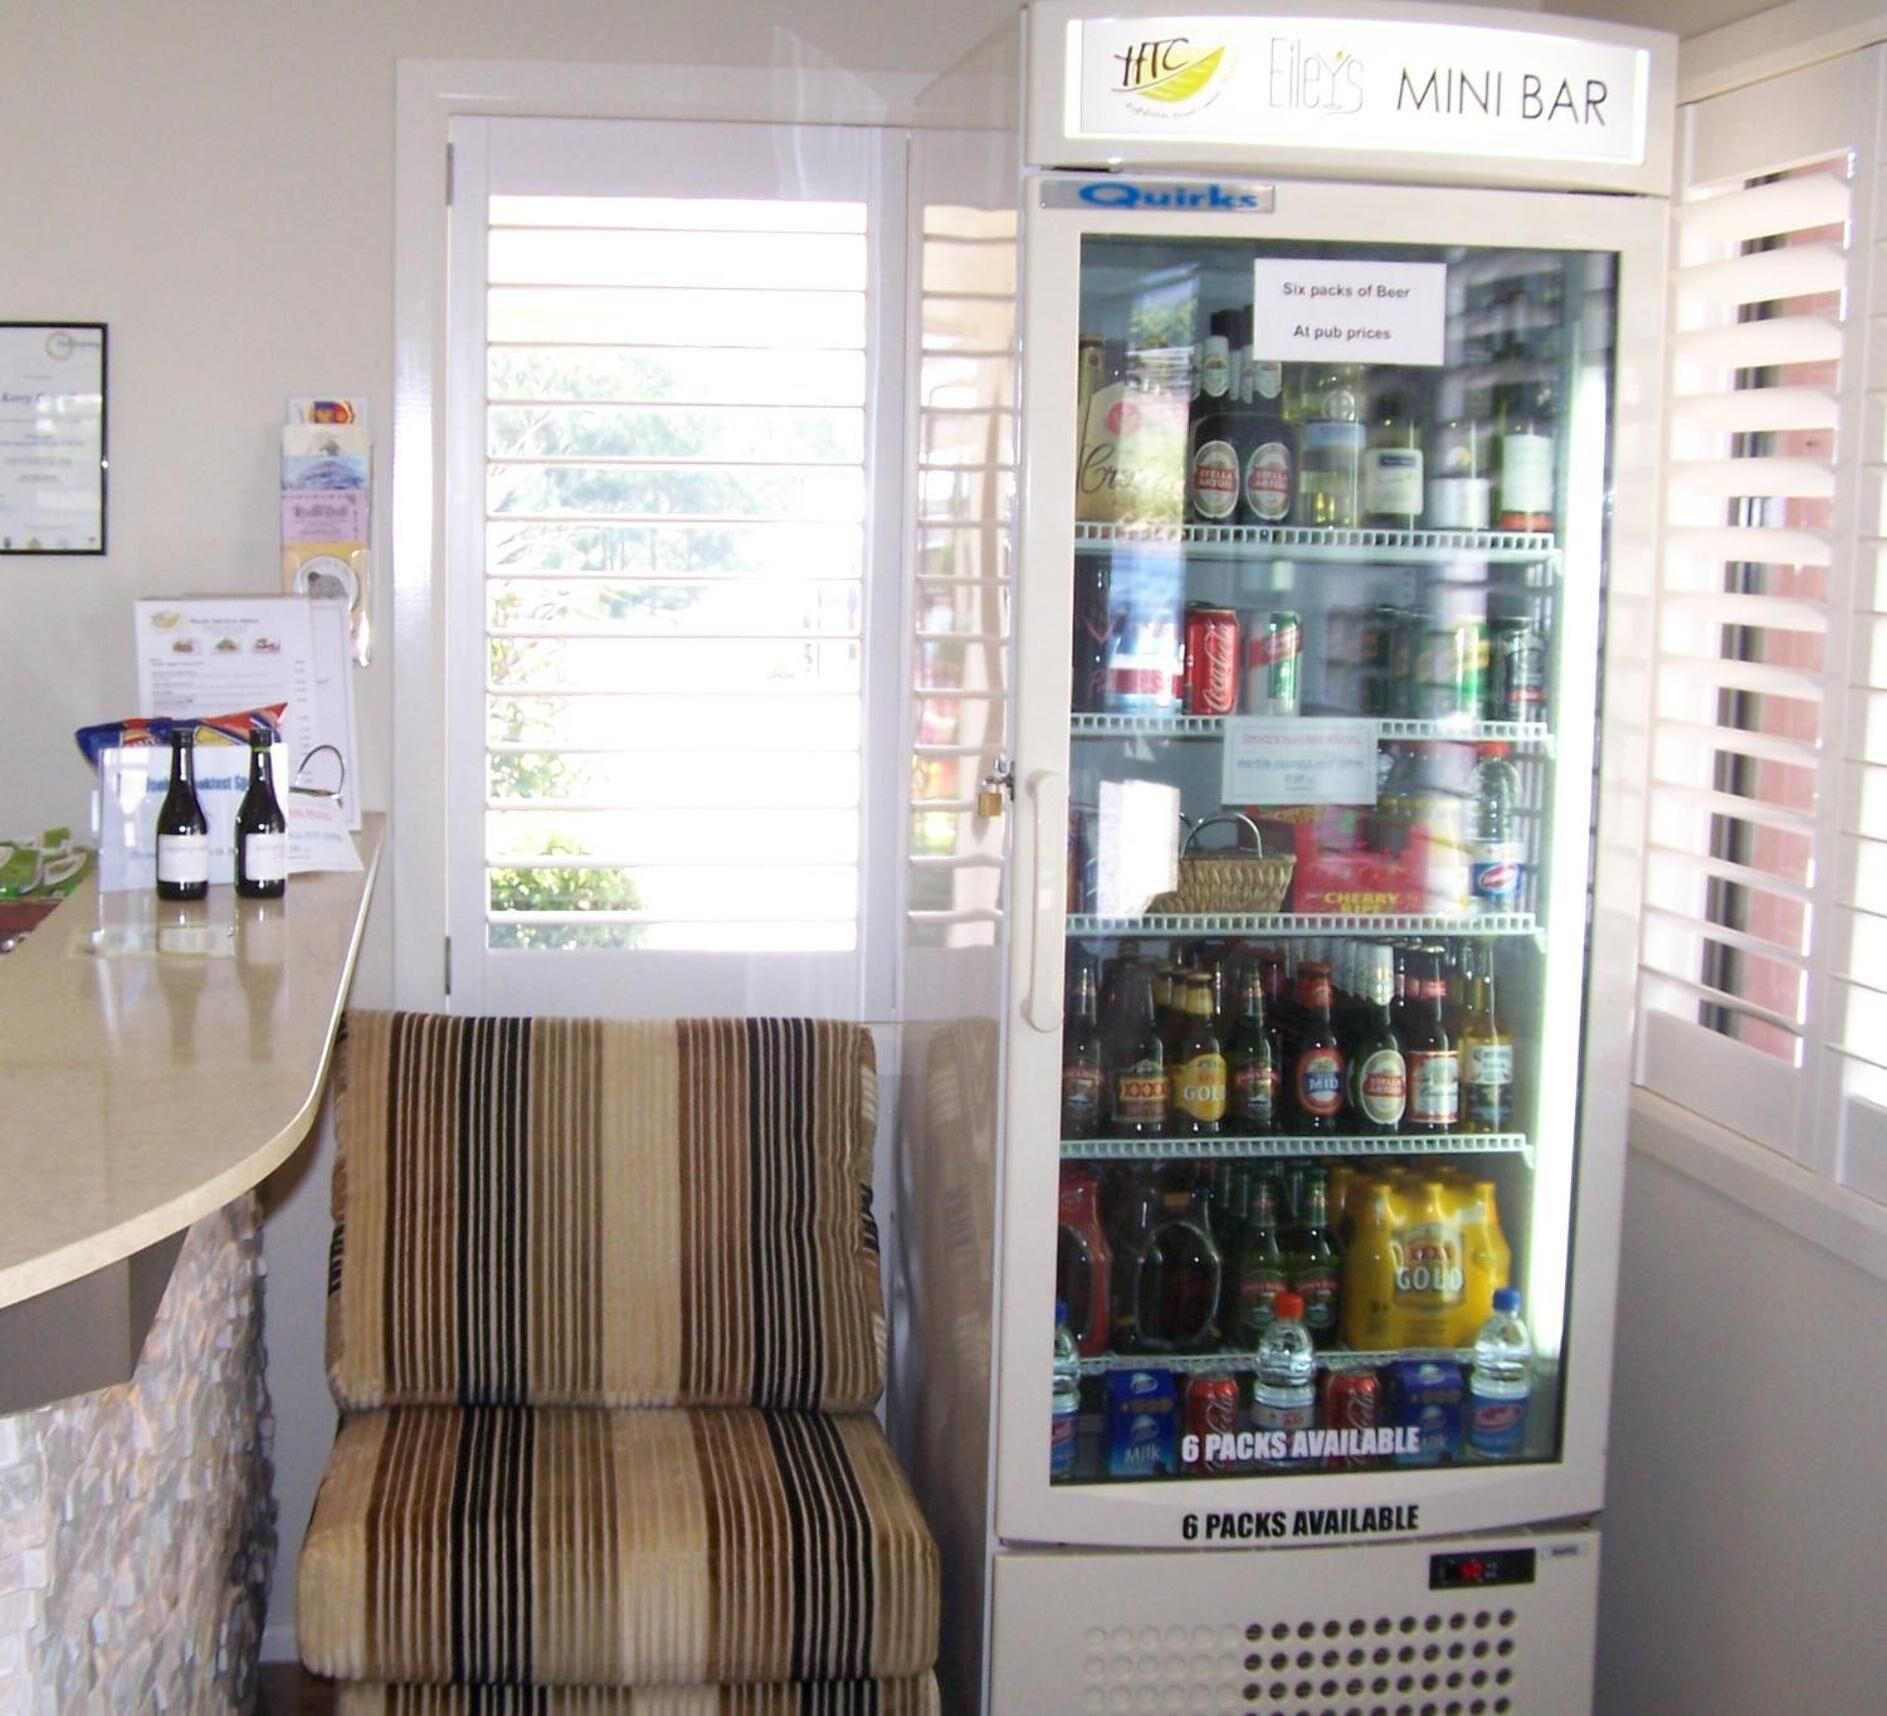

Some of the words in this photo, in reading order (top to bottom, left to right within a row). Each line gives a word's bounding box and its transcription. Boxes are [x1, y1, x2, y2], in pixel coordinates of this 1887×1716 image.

[1397, 67, 1502, 117] MINI
[1522, 73, 1608, 126] BAR
[1078, 182, 1259, 208] Quirks
[1283, 282, 1306, 296] Six
[1310, 283, 1353, 299] packs
[1357, 283, 1373, 298] of
[1376, 284, 1411, 299] Beer
[1293, 324, 1311, 338] At
[1314, 326, 1342, 340] pub
[1347, 326, 1392, 341] prices
[1308, 1077, 1340, 1091] MID
[1396, 1266, 1463, 1291] GOLD
[1182, 1434, 1200, 1463] 6
[1205, 1431, 1287, 1462] PACKS
[1291, 1426, 1420, 1458] AVAILABLE
[1182, 1513, 1198, 1540] 6
[1206, 1511, 1287, 1540] PACKS
[1292, 1504, 1419, 1536] AVAILABLE
